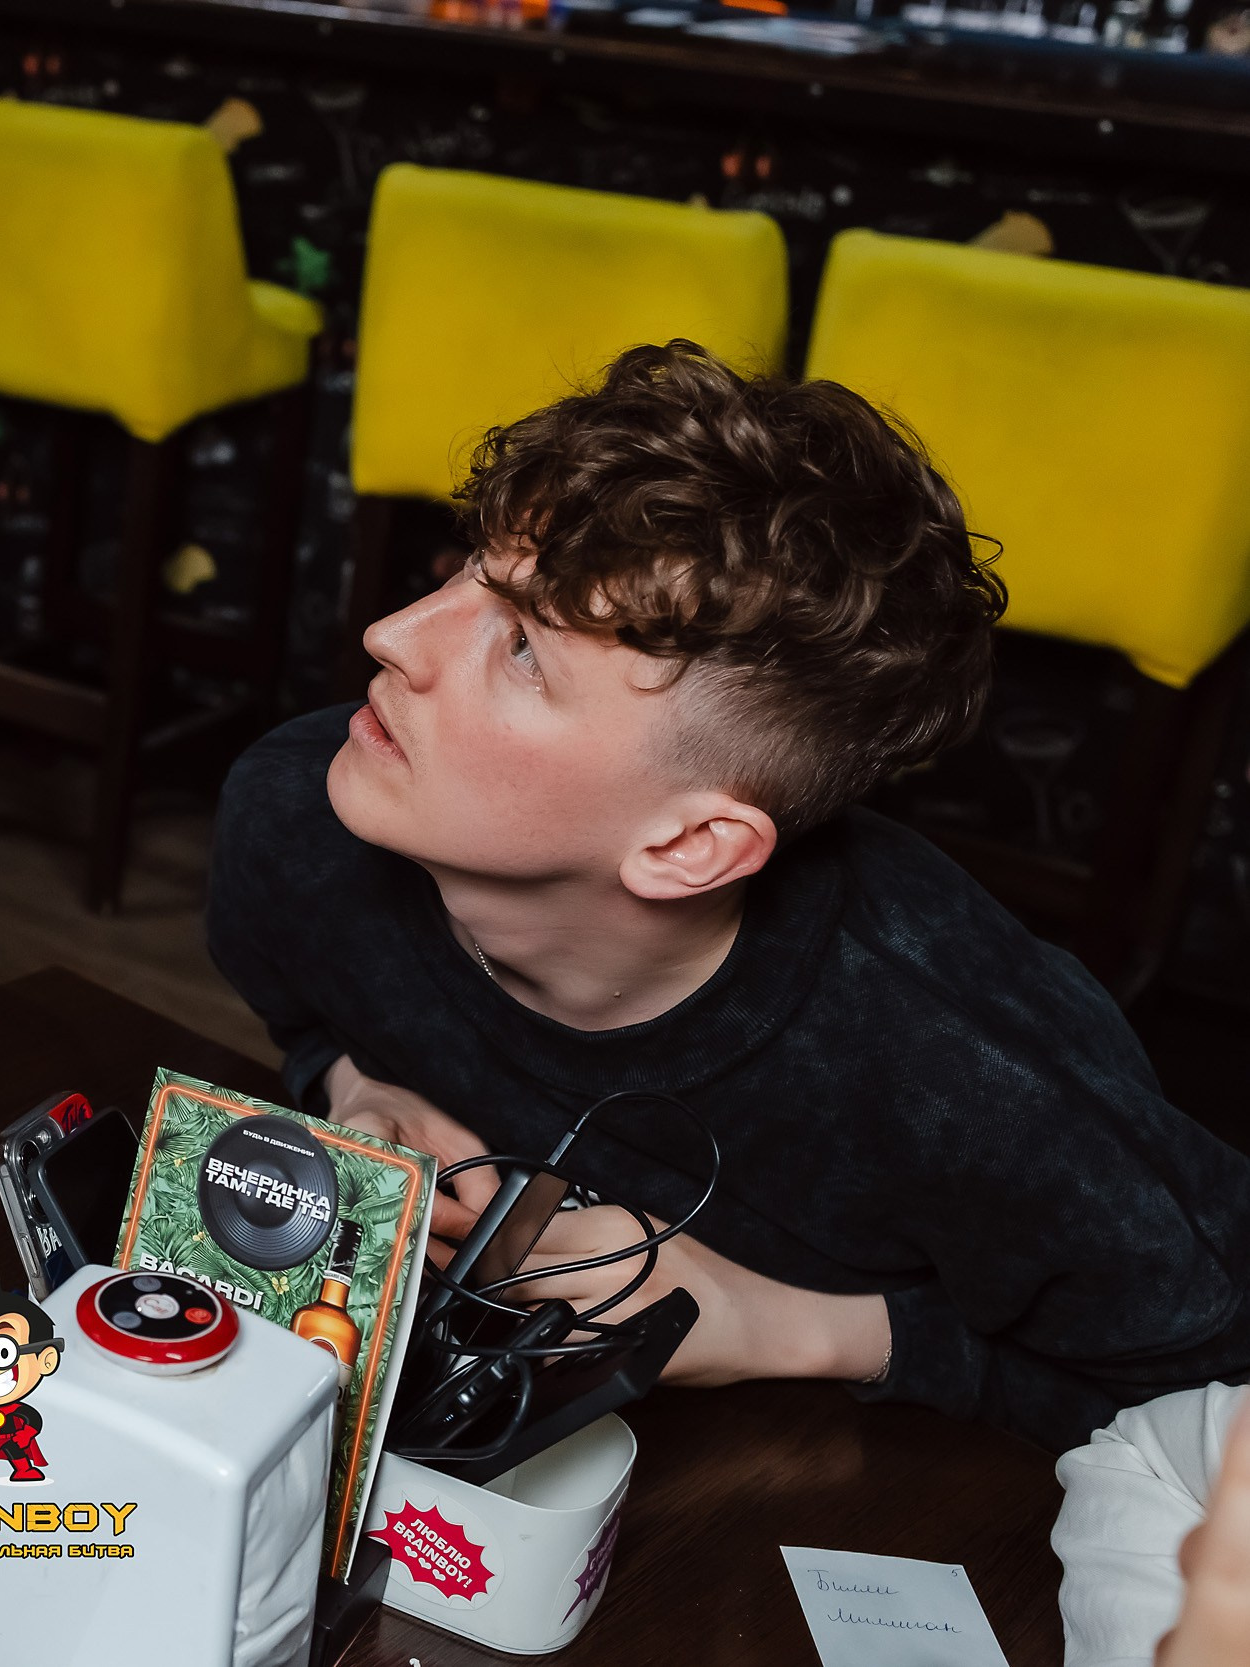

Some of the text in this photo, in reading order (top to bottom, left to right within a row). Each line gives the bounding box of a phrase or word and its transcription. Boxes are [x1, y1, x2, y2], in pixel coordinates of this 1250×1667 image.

[242, 1129, 263, 1141] БУДЬ
[270, 1138, 315, 1158] ДВИЖЕНИИ
[205, 1168, 331, 1223] ТАМ, ГДЕ ТЫ
[207, 1157, 331, 1211] ВЕЧЕРИНКА
[392, 1521, 473, 1589] BRAINBOY!
[410, 1518, 472, 1570] ЛЮБЛЮ
[807, 1568, 962, 1595] Билли 5
[827, 1607, 963, 1634] Миллиган
